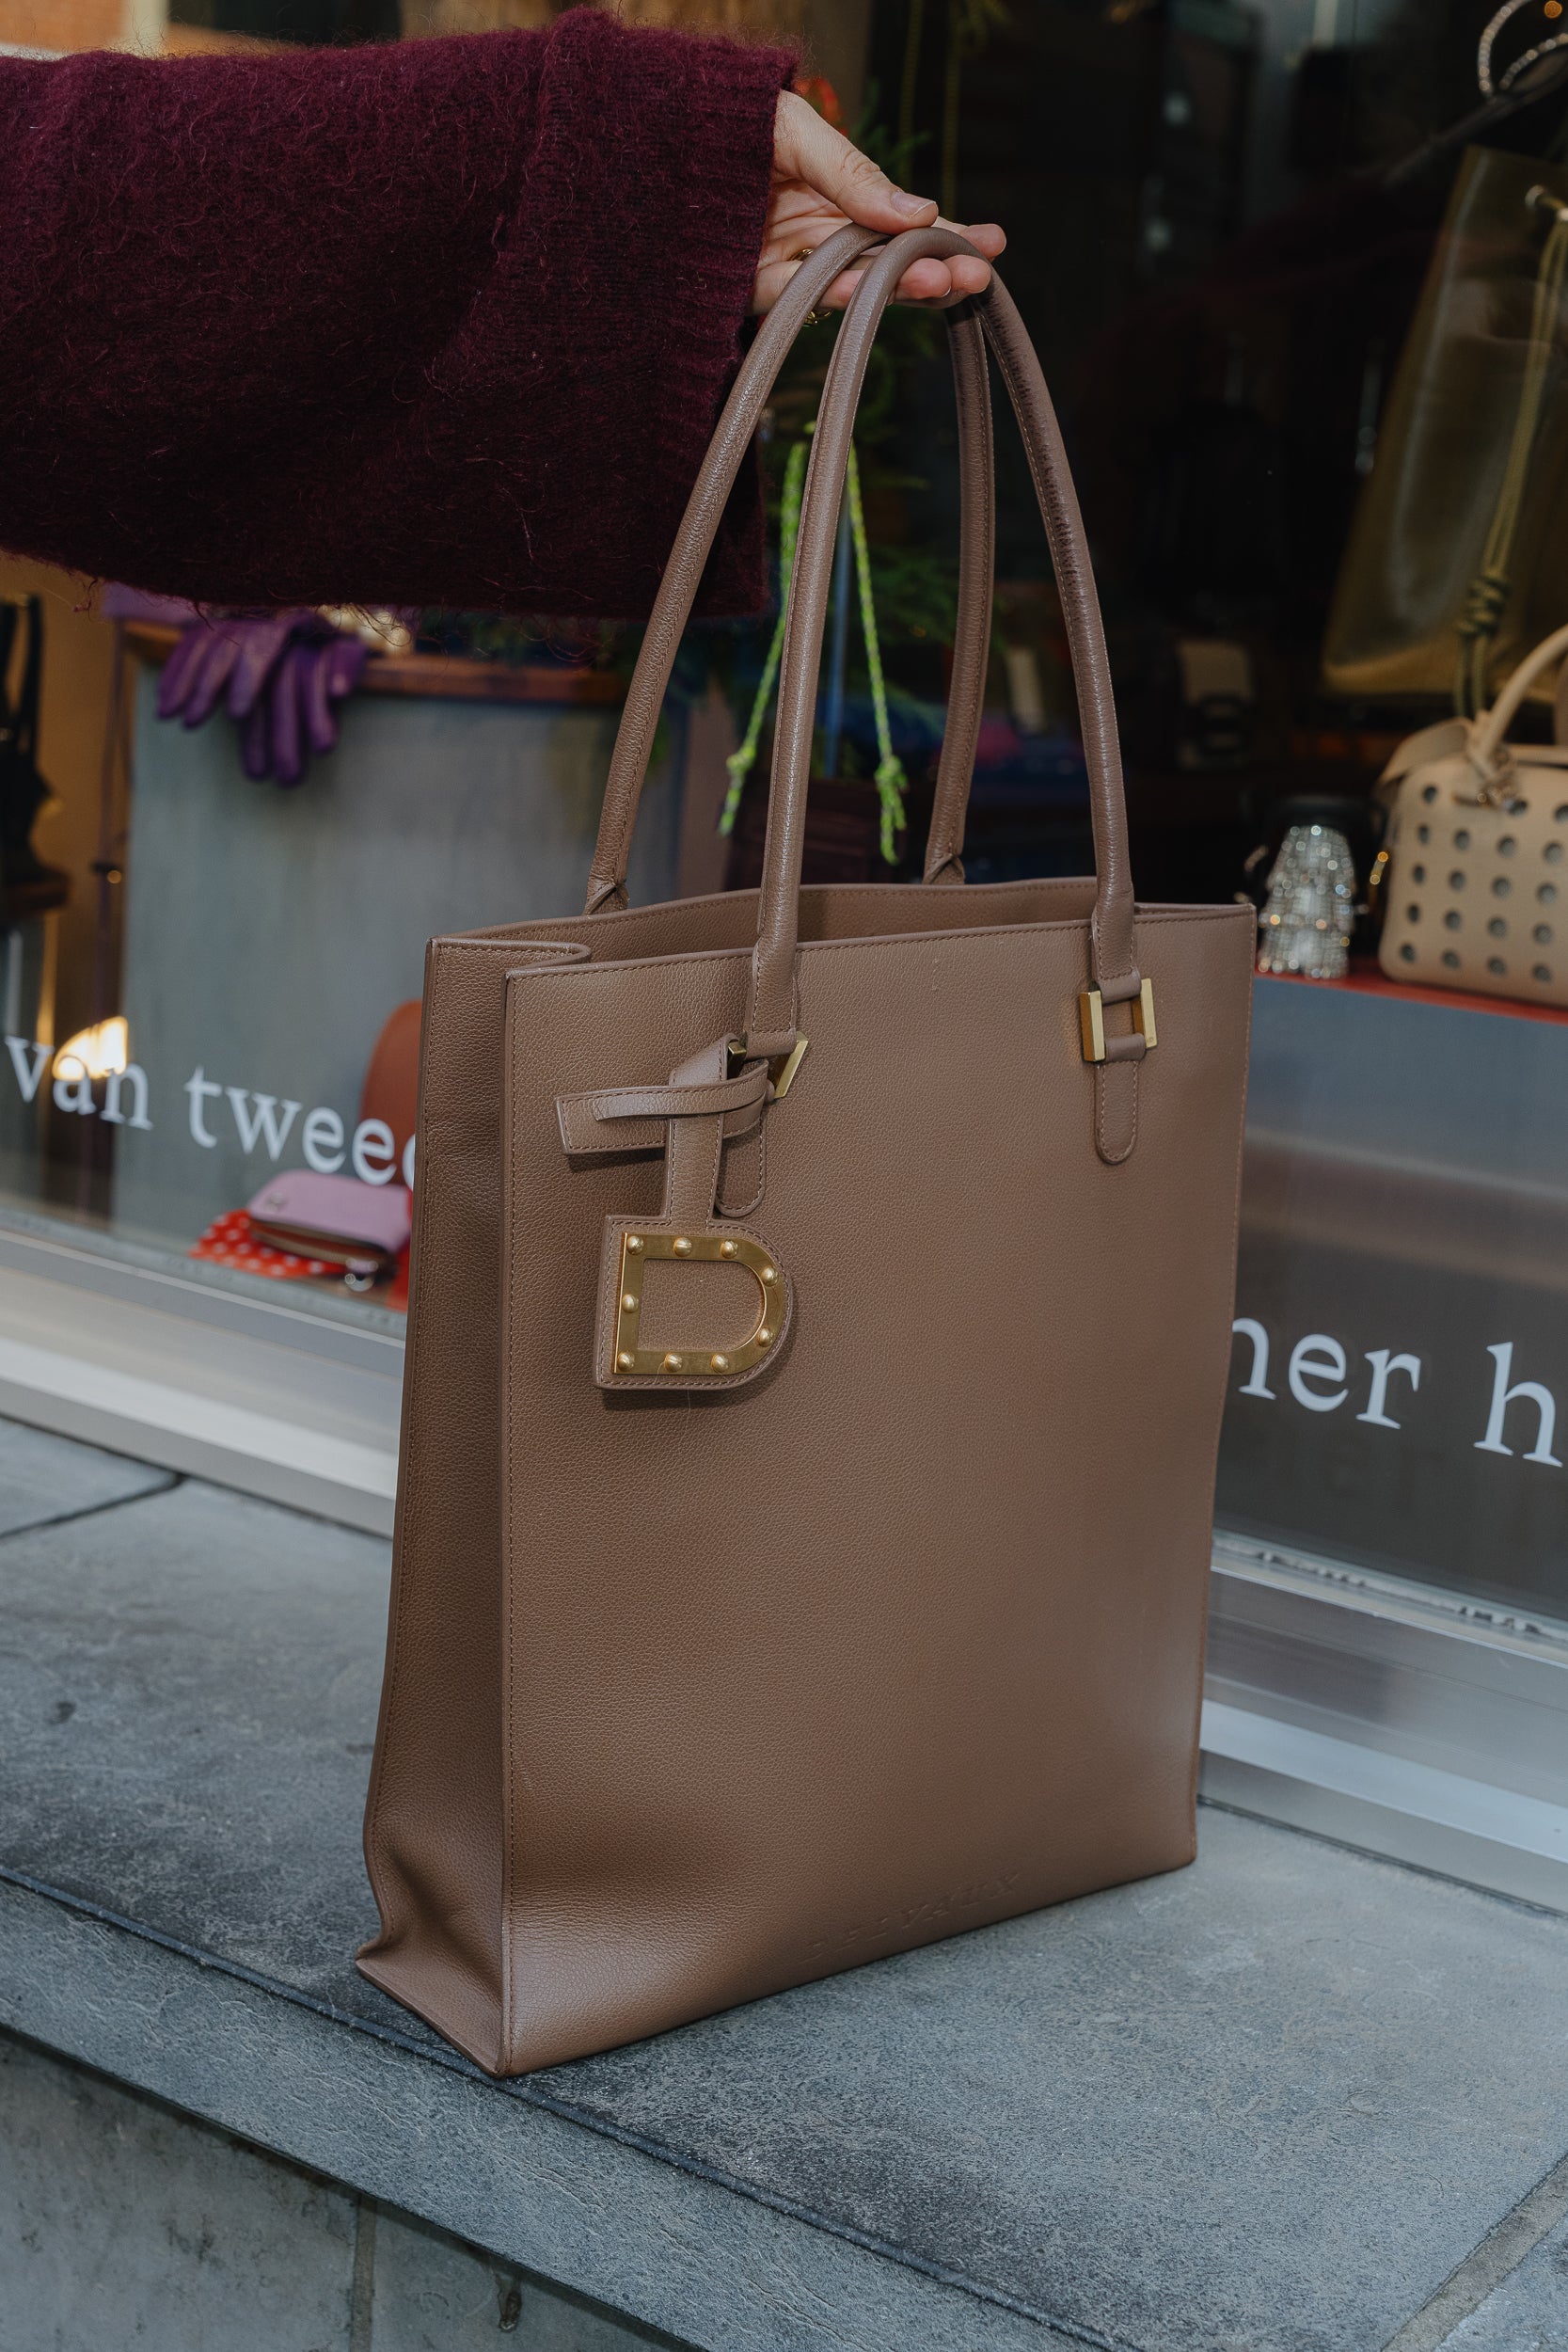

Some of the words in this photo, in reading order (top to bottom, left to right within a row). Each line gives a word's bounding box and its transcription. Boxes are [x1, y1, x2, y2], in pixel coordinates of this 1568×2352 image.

[3, 1035, 153, 1131] van
[183, 1065, 416, 1189] twee
[614, 1232, 787, 1375] D
[1473, 1341, 1564, 1469] h
